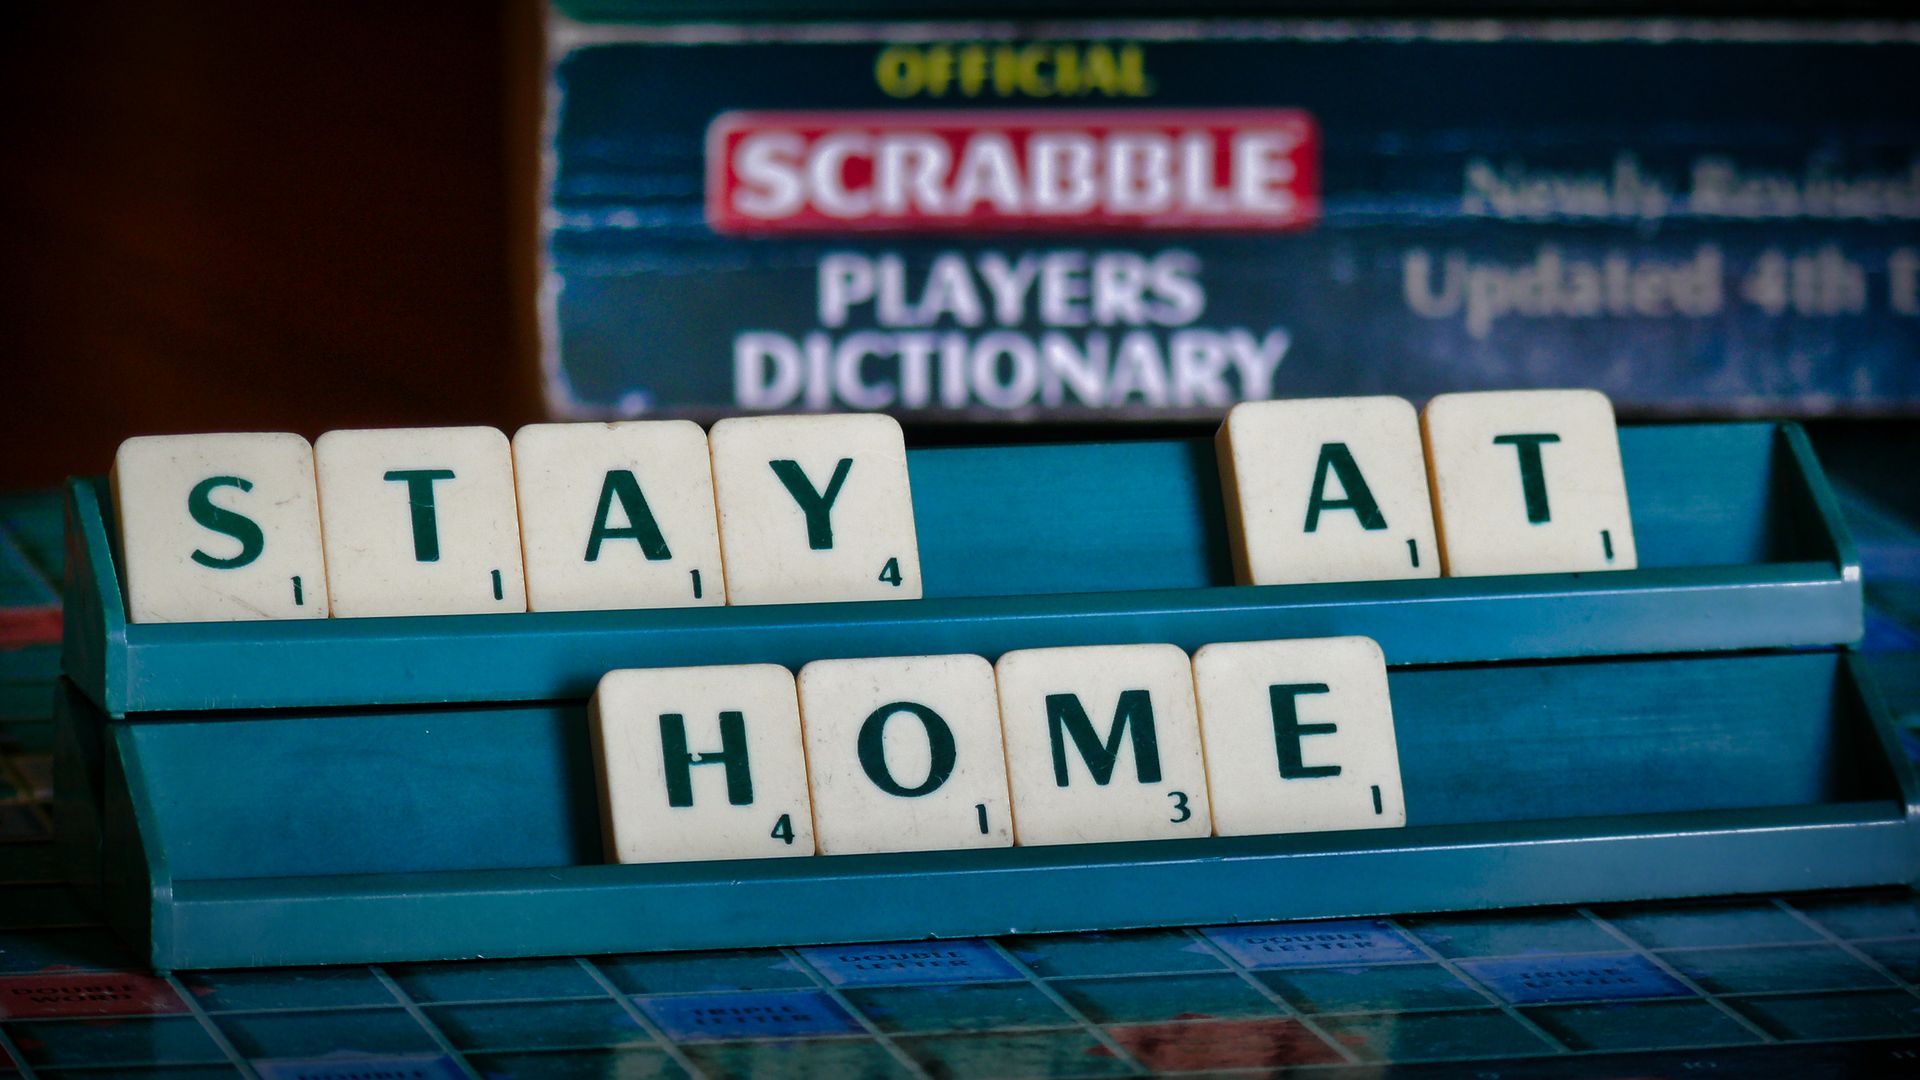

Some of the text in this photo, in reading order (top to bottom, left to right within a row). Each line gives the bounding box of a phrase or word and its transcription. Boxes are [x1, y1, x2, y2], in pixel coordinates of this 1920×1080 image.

[876, 46, 1152, 98] OFFICIAL
[734, 130, 1296, 218] SCRABBLE
[1464, 158, 1666, 238] Newly
[818, 252, 1208, 327] PLAYERS
[1404, 245, 1722, 339] Updated
[1743, 246, 1866, 316] 4th
[734, 330, 1290, 410] DICTIONARY
[188, 433, 1561, 570] STAY AT
[1407, 539, 1419, 569] 1
[1601, 530, 1614, 560] 1
[491, 570, 503, 600] 1
[690, 569, 702, 599] 1
[879, 558, 902, 587] 4
[291, 576, 303, 606] 1
[658, 683, 1342, 808] HOME
[1168, 792, 1191, 824] 3
[1371, 785, 1382, 815] 1
[771, 814, 795, 846] 4
[975, 804, 988, 834] 1
[1246, 932, 1362, 944] DOUBLE
[838, 951, 962, 963] DOUBLE
